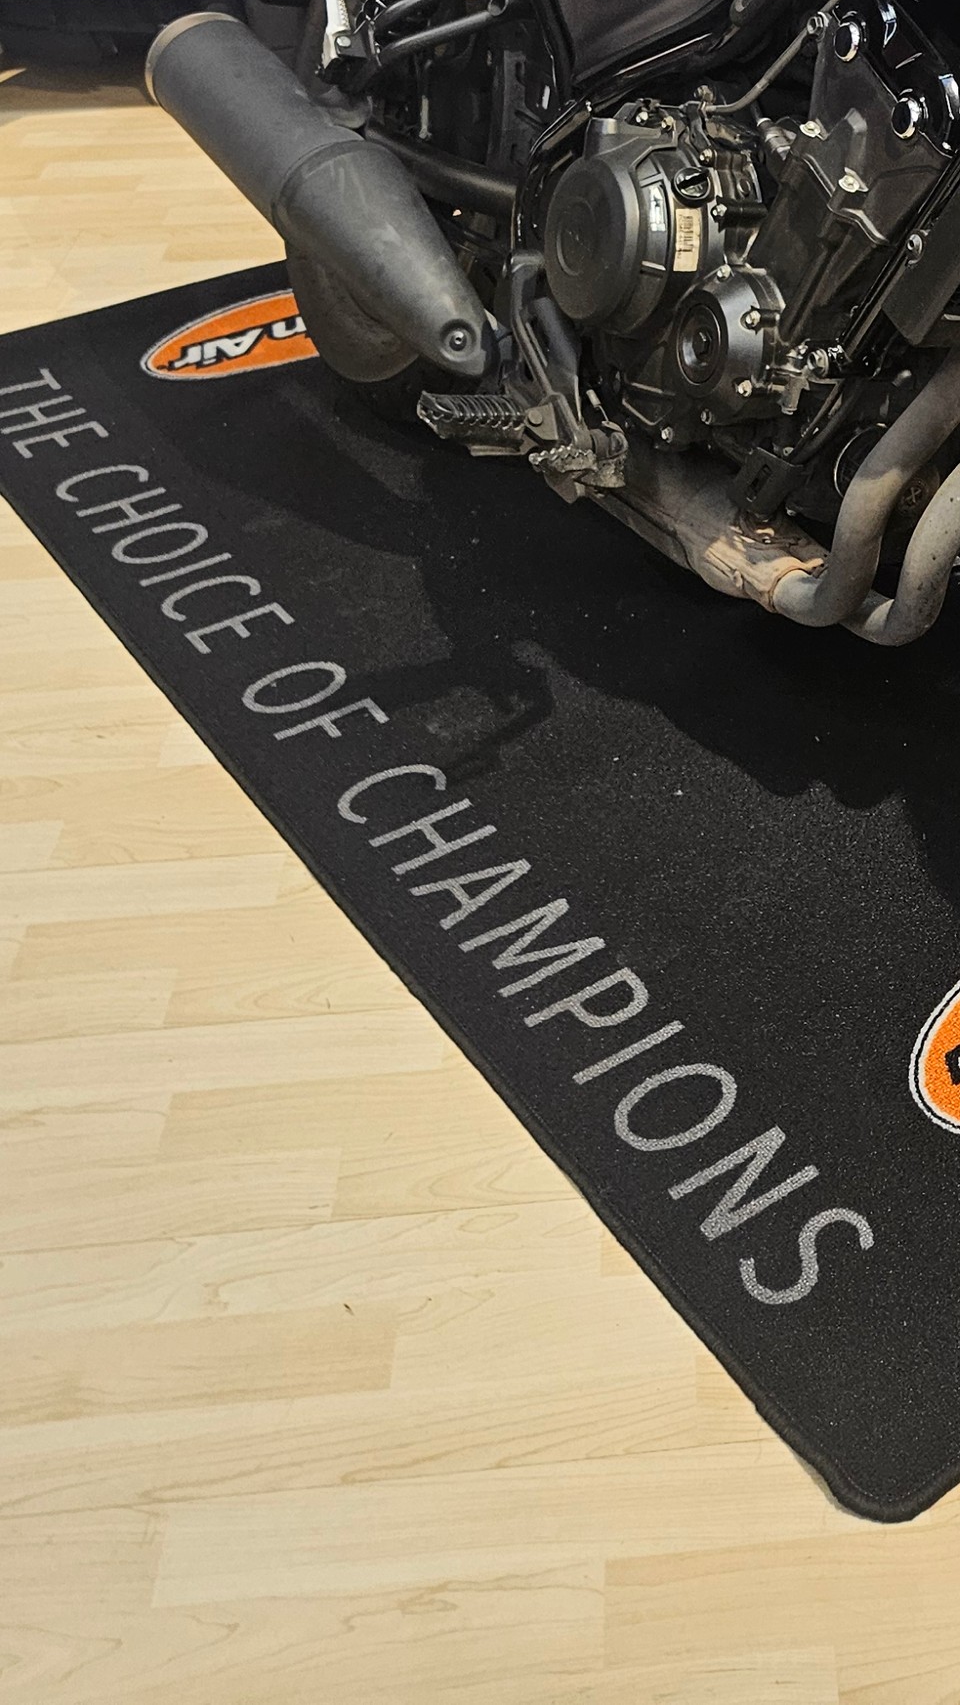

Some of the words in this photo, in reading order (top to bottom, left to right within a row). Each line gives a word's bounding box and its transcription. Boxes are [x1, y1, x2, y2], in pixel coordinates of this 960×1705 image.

[0, 367, 109, 460] THE
[55, 463, 295, 655] CHOICE
[241, 660, 390, 741] OF
[336, 763, 876, 1305] CHAMPIONS
